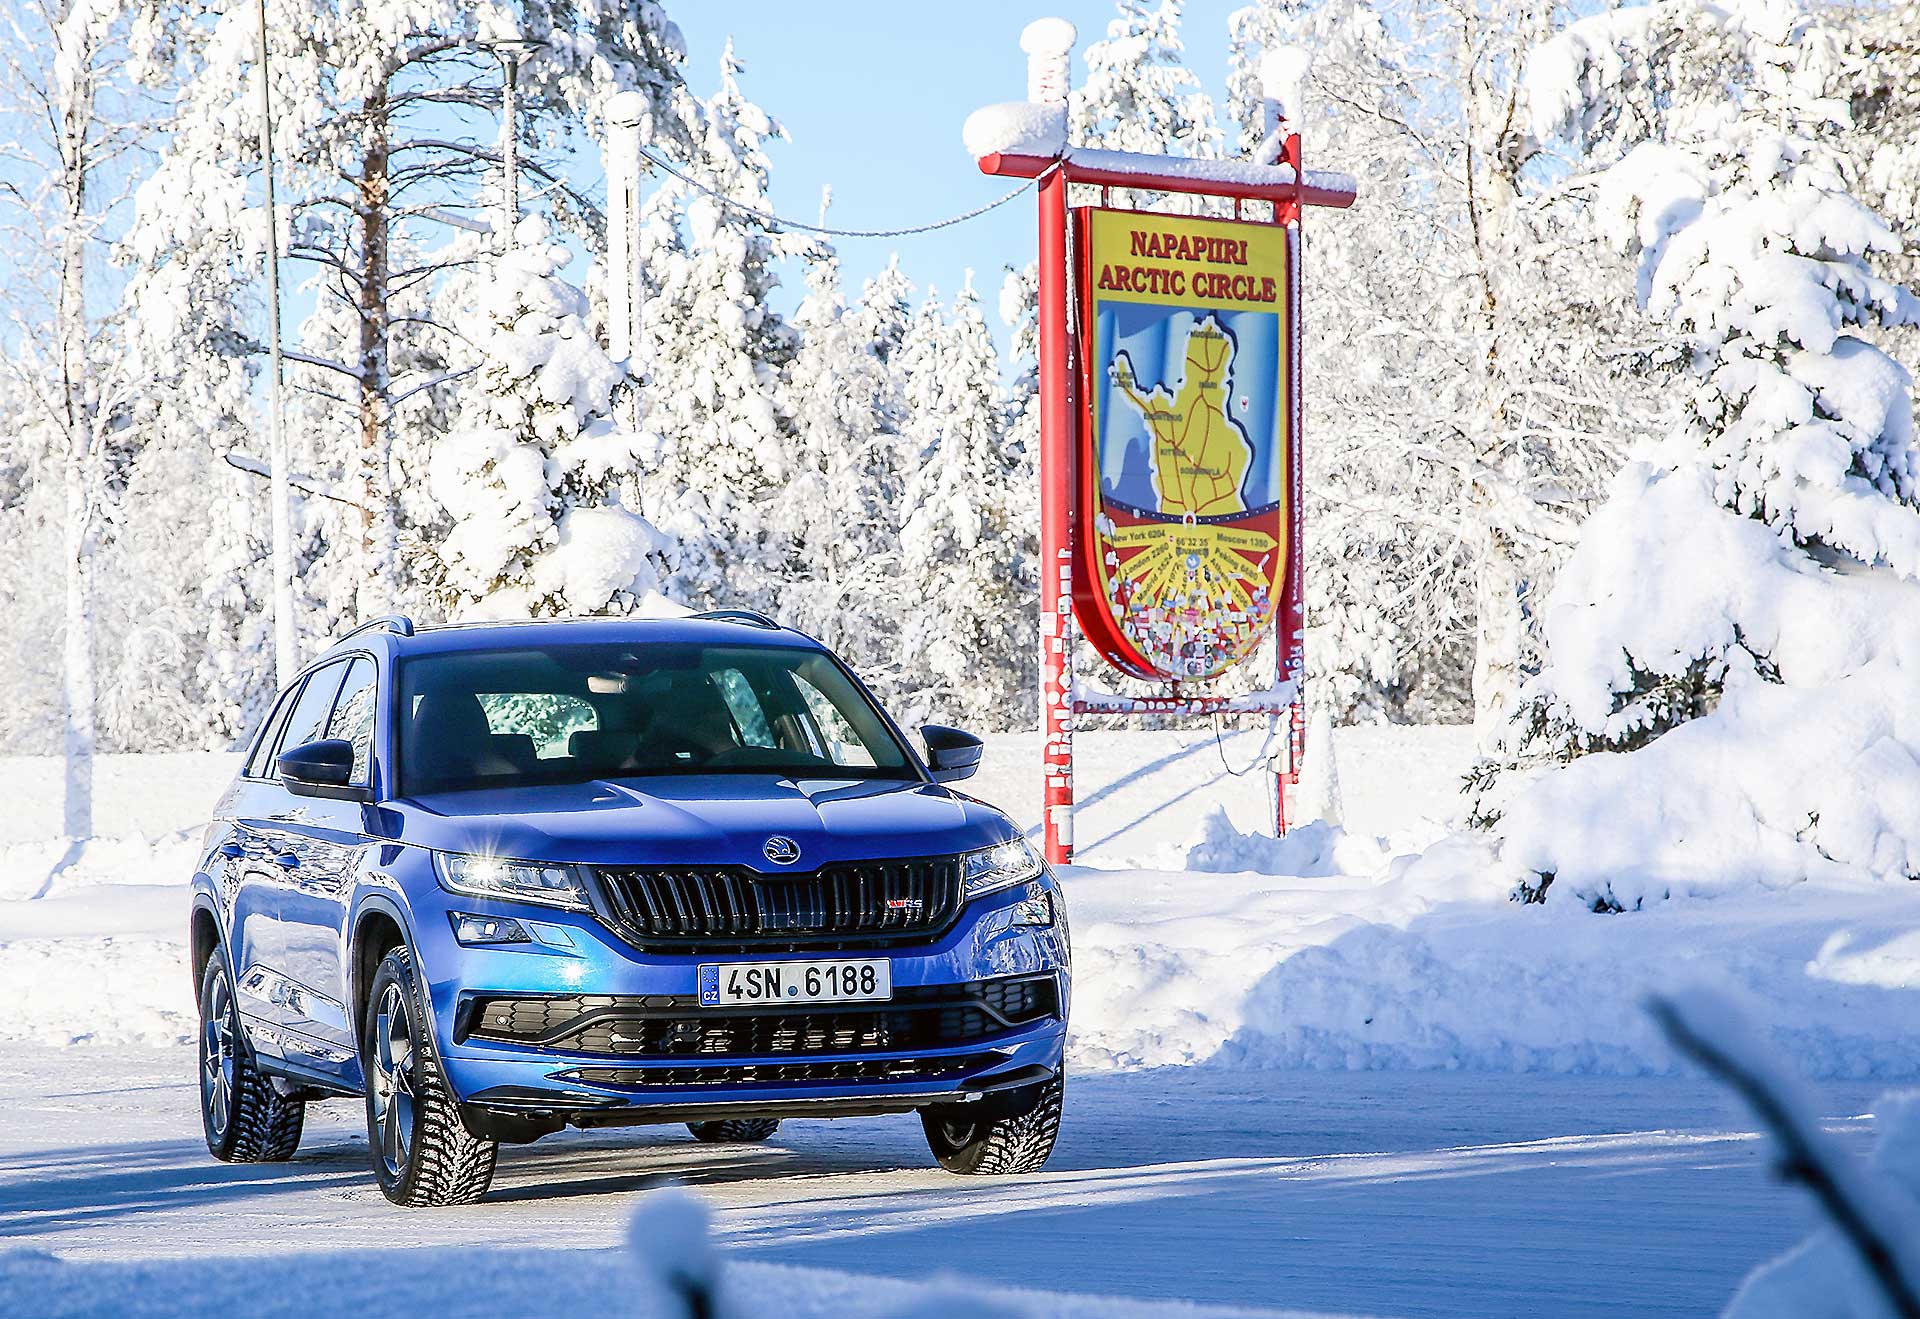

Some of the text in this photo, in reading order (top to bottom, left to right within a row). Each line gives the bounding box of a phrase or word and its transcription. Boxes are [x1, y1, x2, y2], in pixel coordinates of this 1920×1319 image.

[1130, 231, 1248, 265] NAPAPIIRI
[1098, 264, 1277, 302] ARCTIC CIRCLE
[1129, 532, 1146, 540] York
[1217, 533, 1248, 544] Moscow
[1124, 556, 1151, 575] London
[1215, 547, 1239, 570] Peking
[1137, 574, 1159, 601] Madrid
[703, 964, 876, 1001] CZ 4SN 6188
